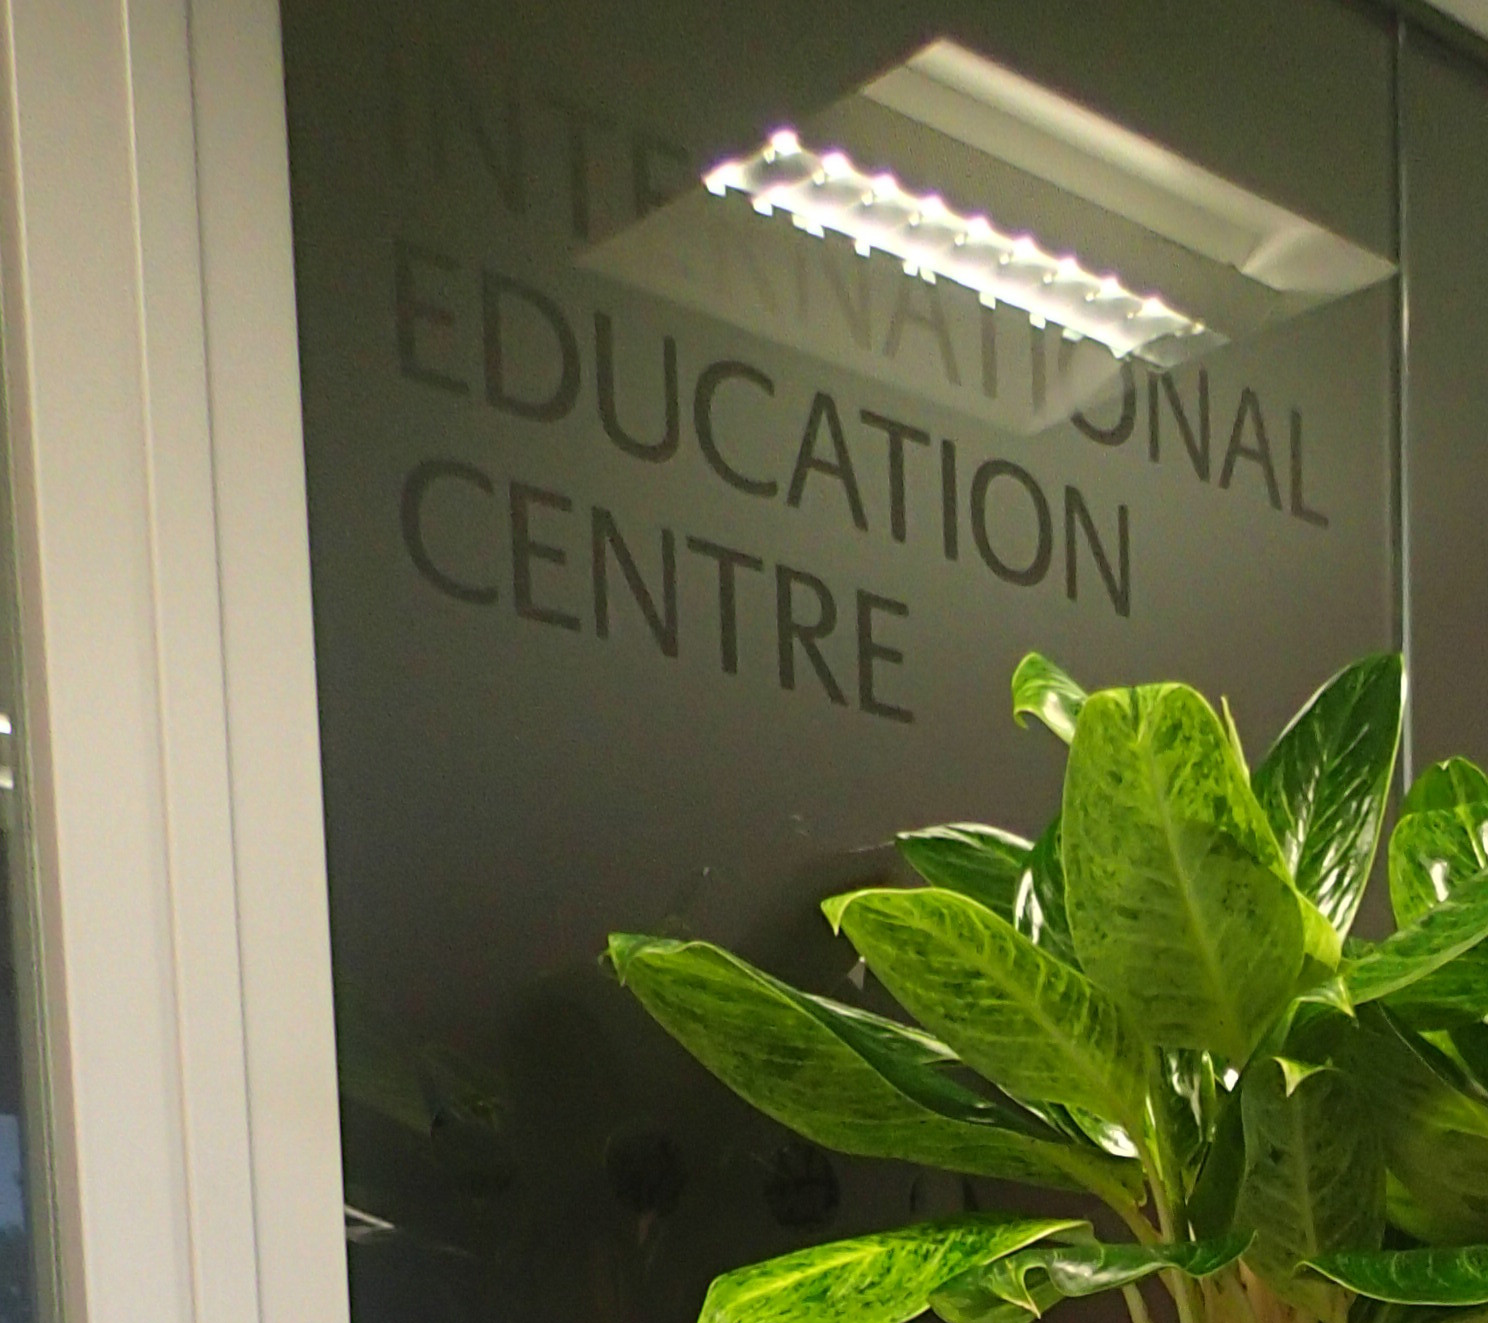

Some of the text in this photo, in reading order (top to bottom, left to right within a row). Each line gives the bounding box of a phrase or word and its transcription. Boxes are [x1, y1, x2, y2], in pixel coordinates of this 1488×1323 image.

[389, 20, 1328, 527] INTENATIONAL
[392, 239, 1130, 617] EDUCATION
[401, 457, 914, 722] CENTRE
